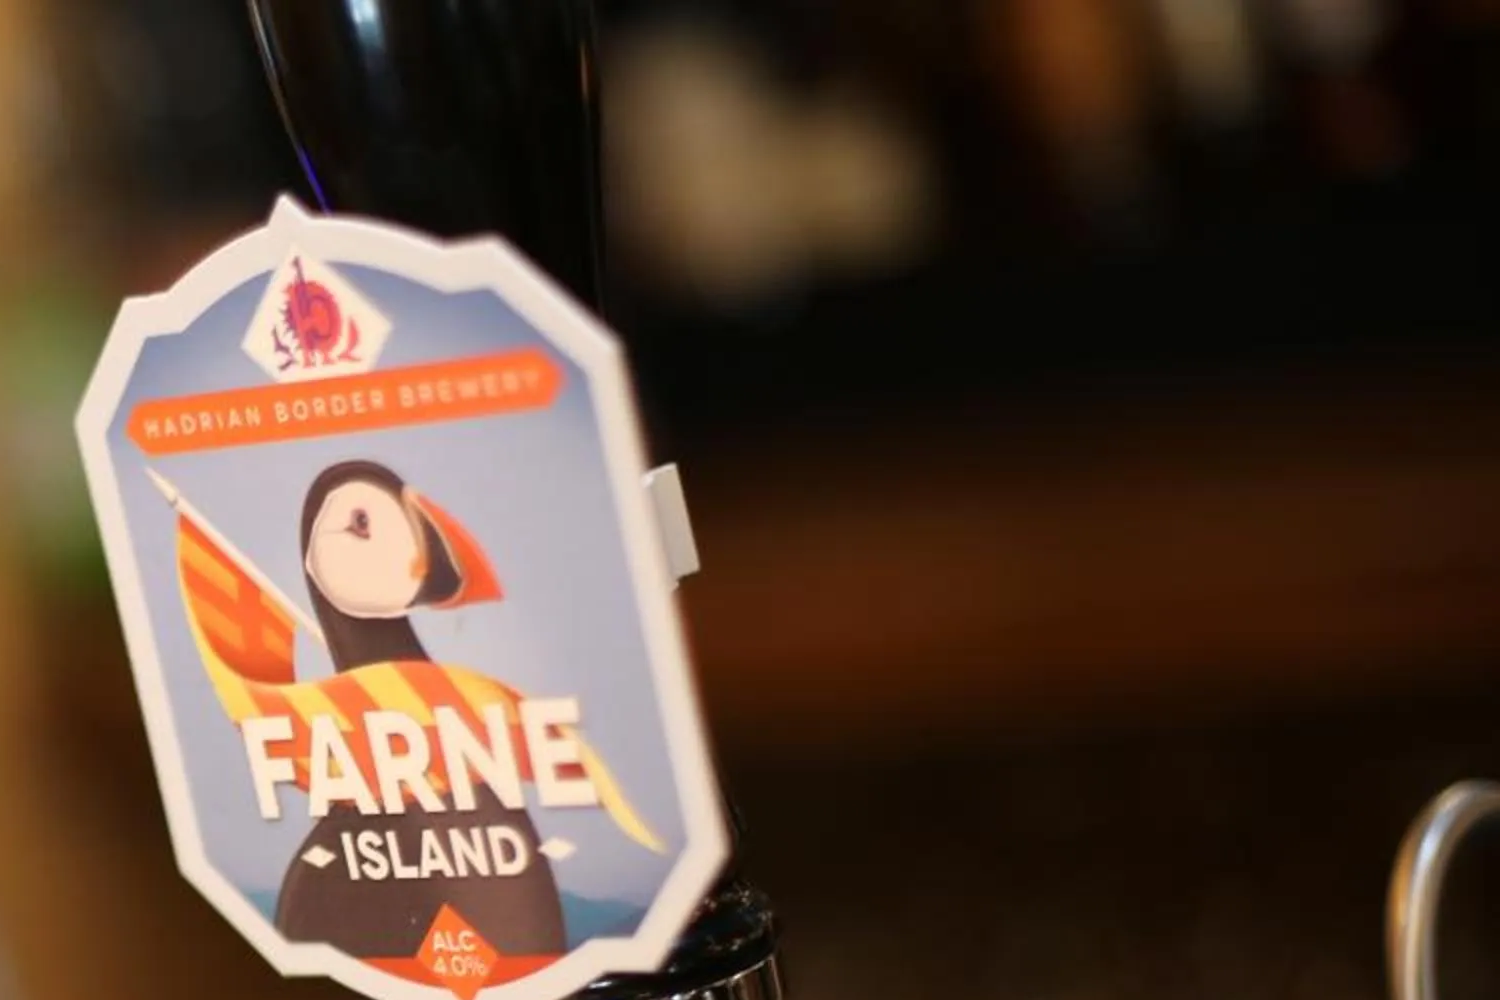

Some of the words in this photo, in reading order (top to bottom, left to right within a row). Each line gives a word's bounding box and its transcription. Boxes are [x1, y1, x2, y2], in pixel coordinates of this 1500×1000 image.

[143, 404, 262, 440] HADRIAN
[273, 389, 386, 424] BORDER
[398, 368, 540, 408] BREWERY
[241, 697, 605, 820] FARNE
[340, 826, 531, 881] ISLAND
[432, 929, 477, 952] ALC
